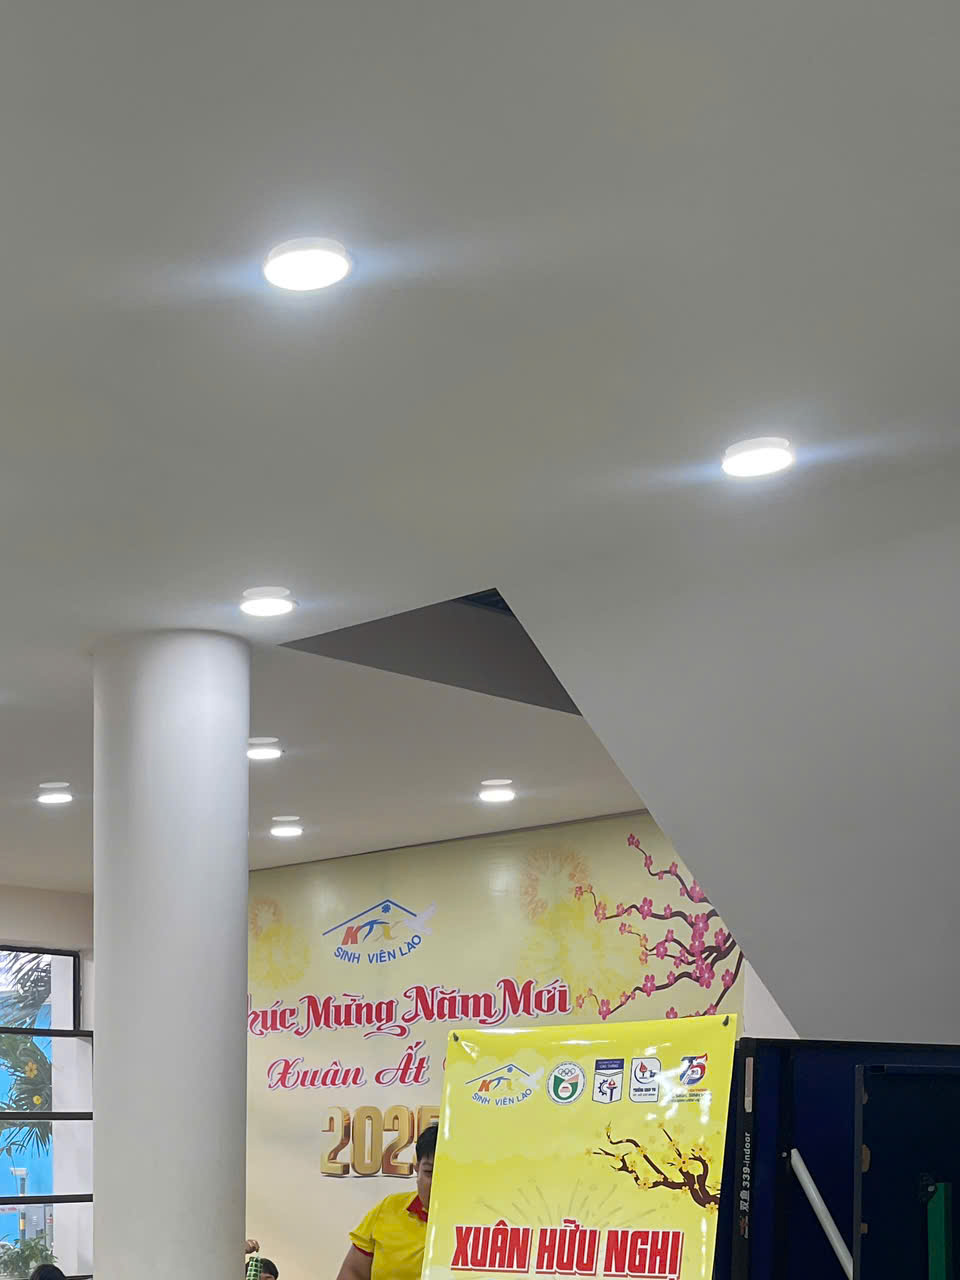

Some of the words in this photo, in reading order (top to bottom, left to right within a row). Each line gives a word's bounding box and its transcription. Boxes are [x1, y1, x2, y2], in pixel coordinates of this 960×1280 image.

[334, 946, 361, 964] SINH
[368, 949, 397, 964] VIÊN
[398, 934, 422, 957] LÀO
[294, 993, 410, 1039] Mừng
[401, 984, 495, 1024] Năm
[479, 977, 573, 1026] Mới
[267, 1056, 367, 1091] Xuân
[375, 1040, 430, 1087] Ất
[472, 1092, 490, 1104] SINH
[495, 1097, 514, 1106] VIÊN
[320, 1105, 440, 1178] 202
[451, 1219, 533, 1274] XUÂN
[535, 1218, 601, 1276] HỮU
